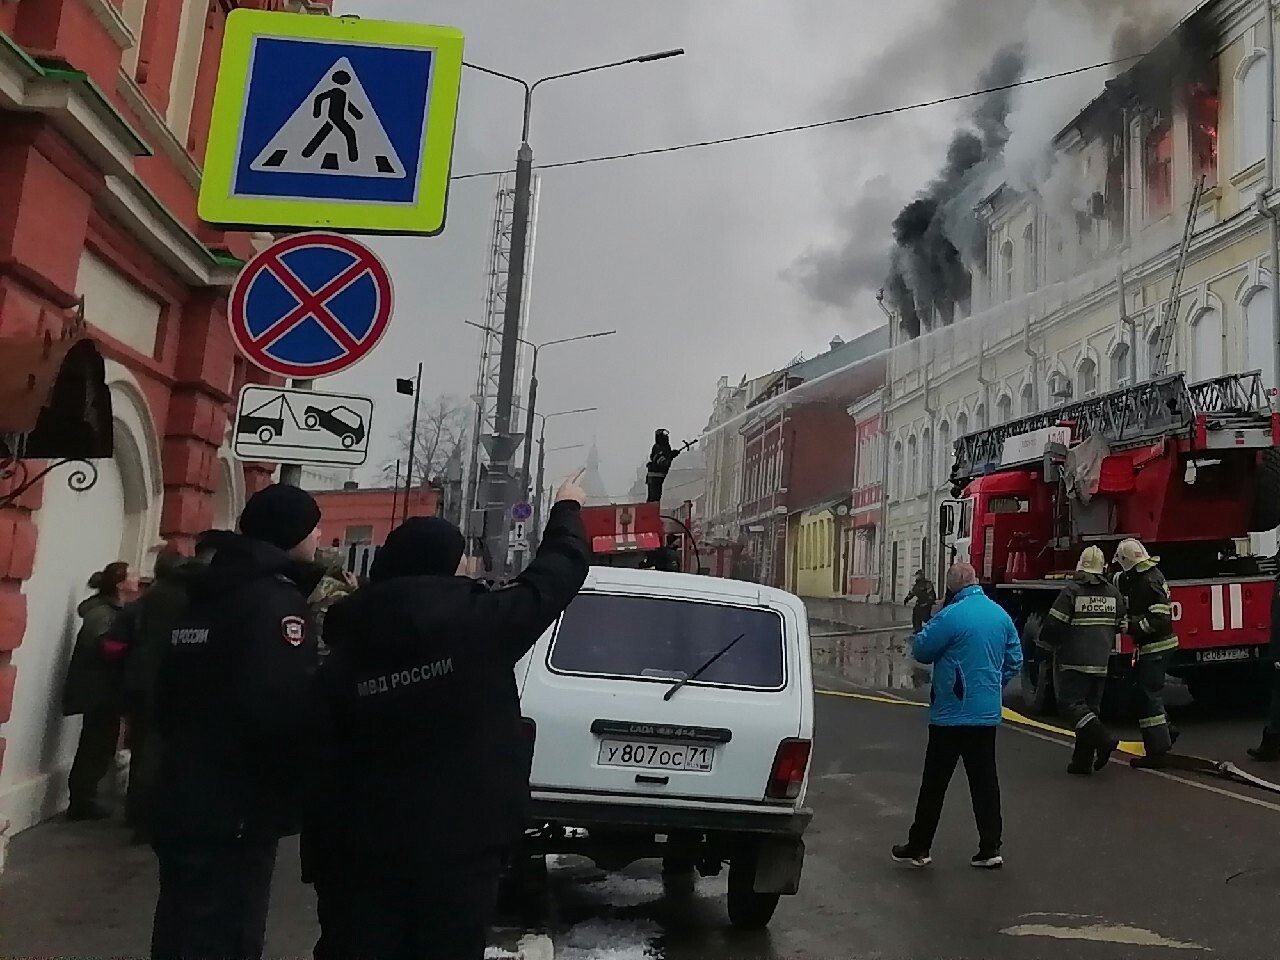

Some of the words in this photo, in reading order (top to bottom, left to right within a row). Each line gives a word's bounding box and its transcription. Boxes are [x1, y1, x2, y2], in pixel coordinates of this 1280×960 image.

[357, 675, 388, 697] МВД
[391, 658, 453, 688] РОССИИ
[690, 747, 708, 762] 71
